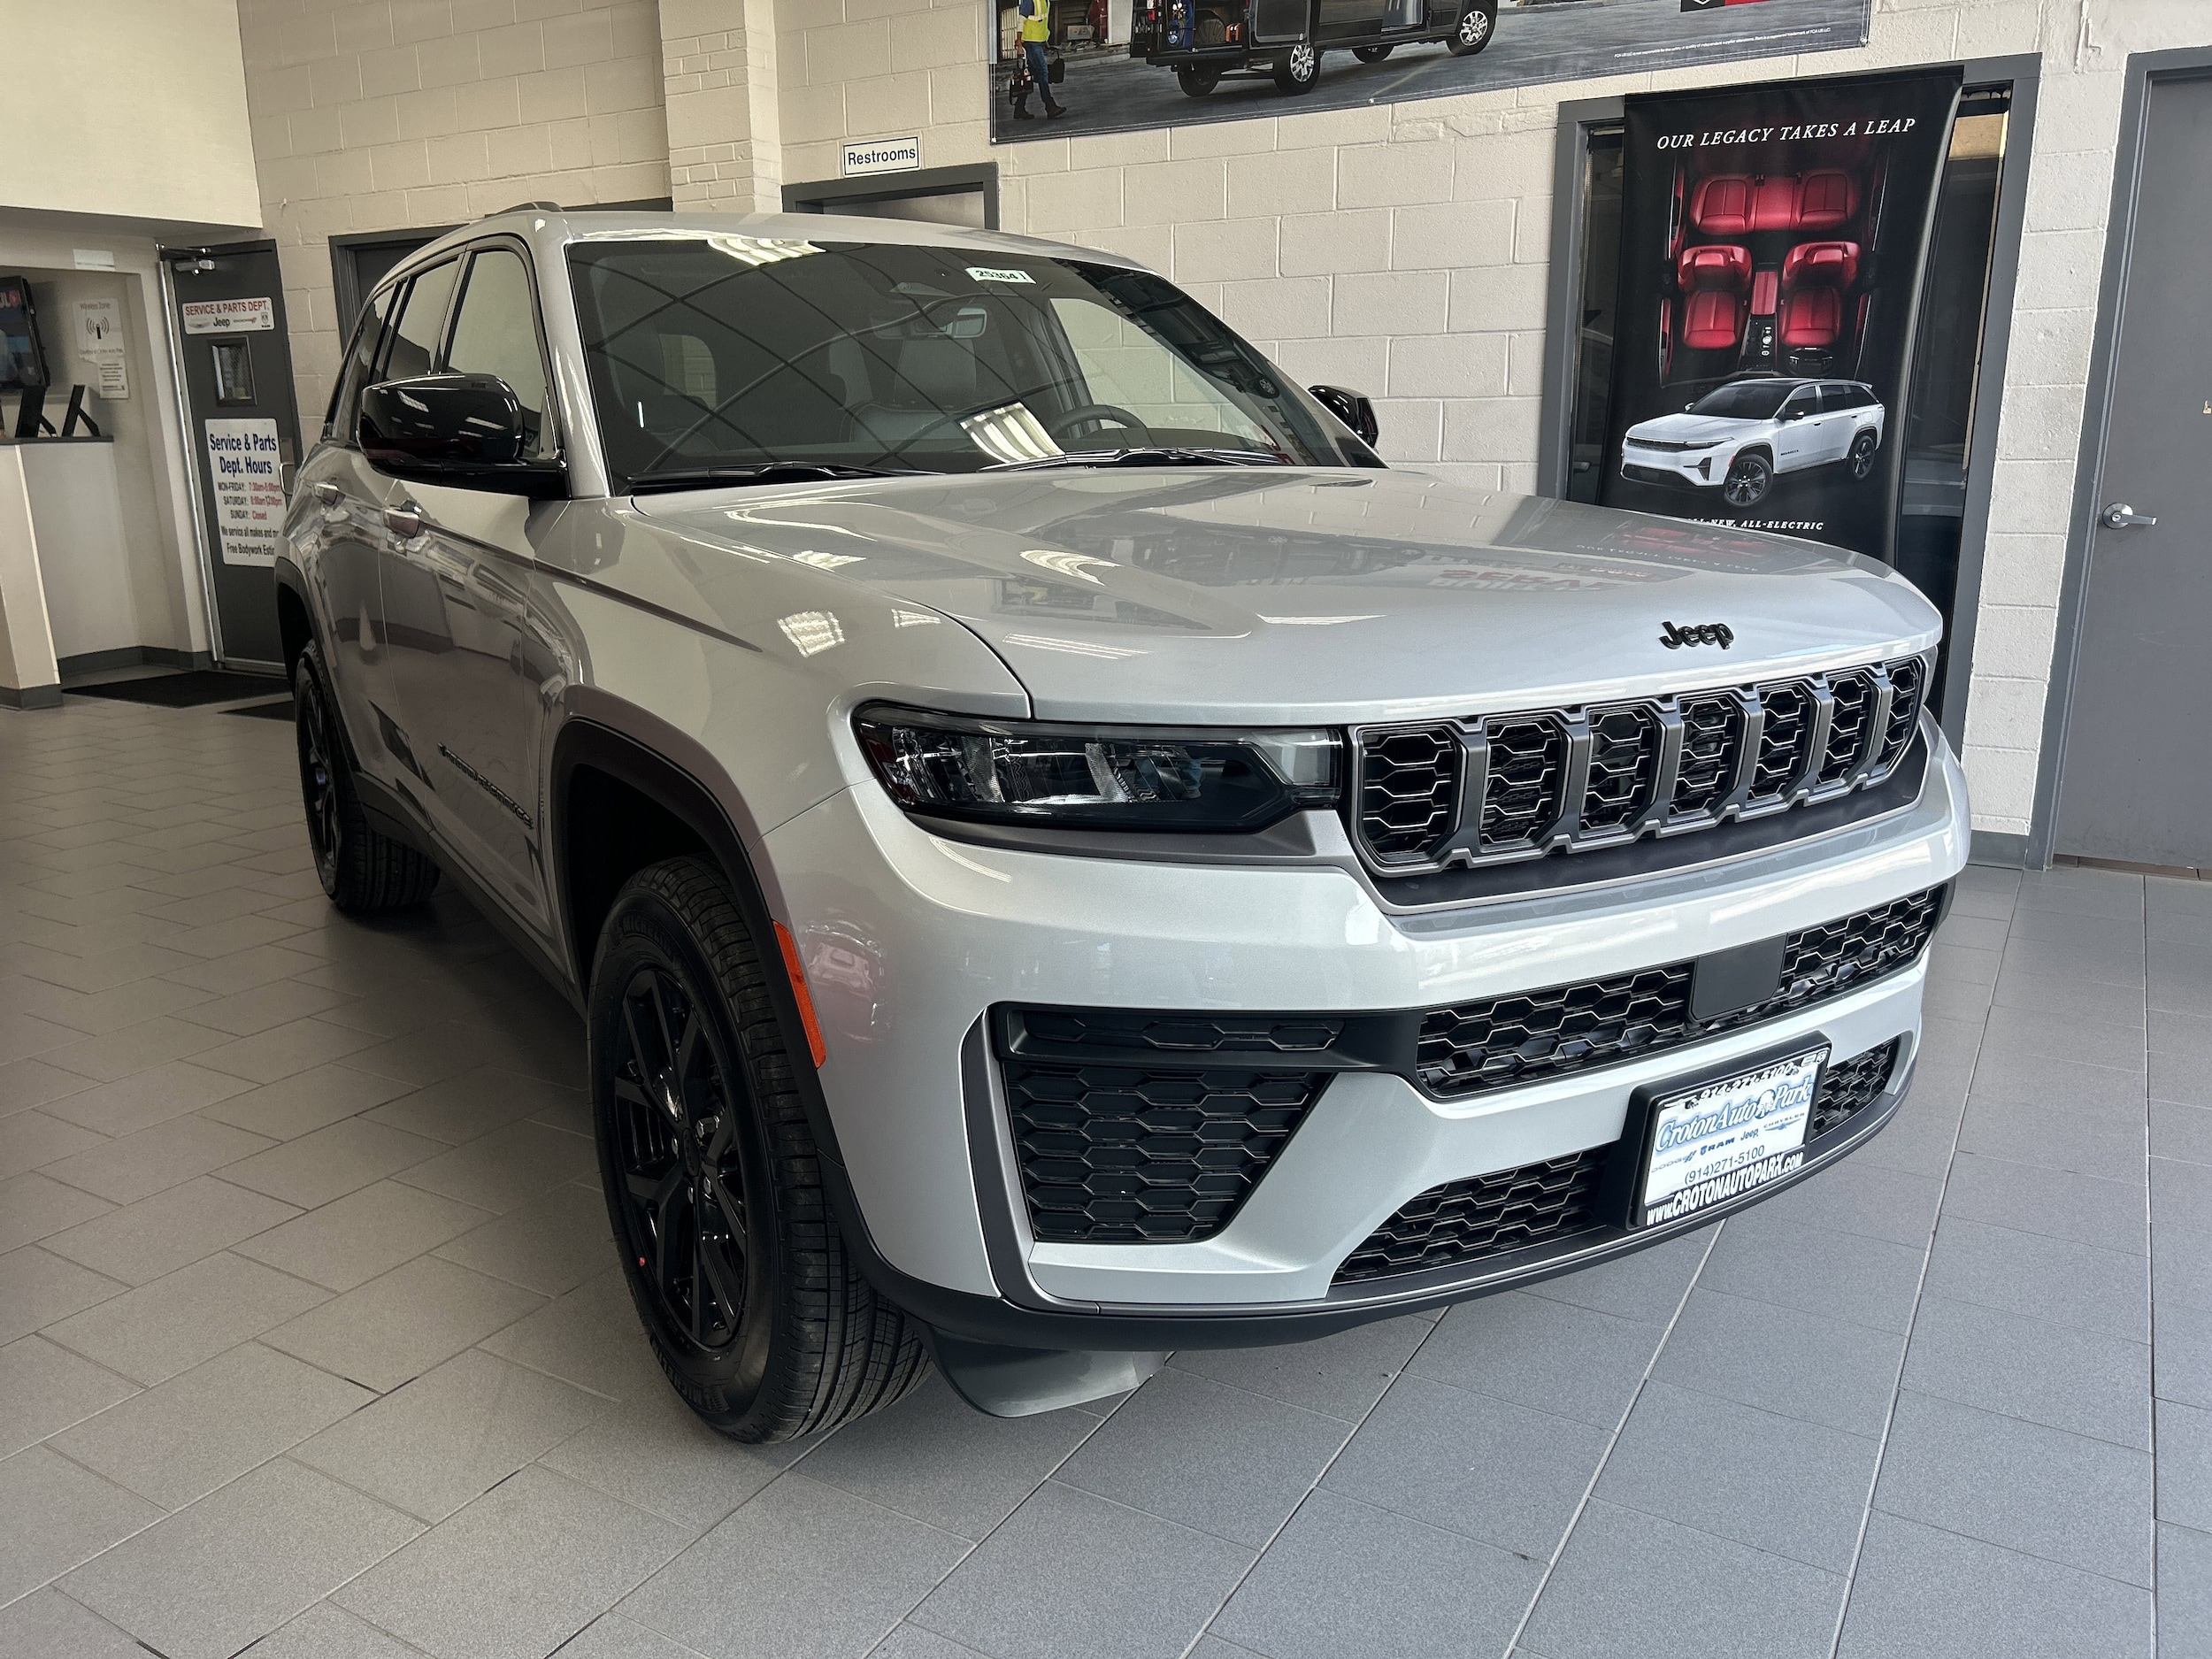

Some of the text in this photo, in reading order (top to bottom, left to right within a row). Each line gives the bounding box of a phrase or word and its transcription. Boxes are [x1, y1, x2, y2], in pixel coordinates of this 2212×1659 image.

[1657, 118, 1916, 150] OUR LEGACY TAKES A LEAP
[848, 148, 916, 165] Restrooms
[185, 300, 270, 316] SERVICE & PARTS DEPT.
[213, 317, 230, 328] Jeep
[210, 434, 277, 451] Service & Parts
[219, 456, 273, 478] Dept. Hours
[252, 511, 267, 520] Closed
[221, 526, 227, 536] We
[228, 526, 243, 536] service
[250, 527, 264, 537] makes
[264, 527, 273, 538] and
[1741, 520, 1824, 531] ALL-ELECTRIC
[227, 542, 238, 554] Free
[238, 543, 263, 557] Bodywork
[1658, 620, 1734, 649] Jeep
[1708, 1137, 1735, 1151] RAM
[1740, 1128, 1759, 1141] Jeep
[1763, 1112, 1805, 1128] CHRYSLER
[1685, 1145, 1765, 1185] (914)271-5100
